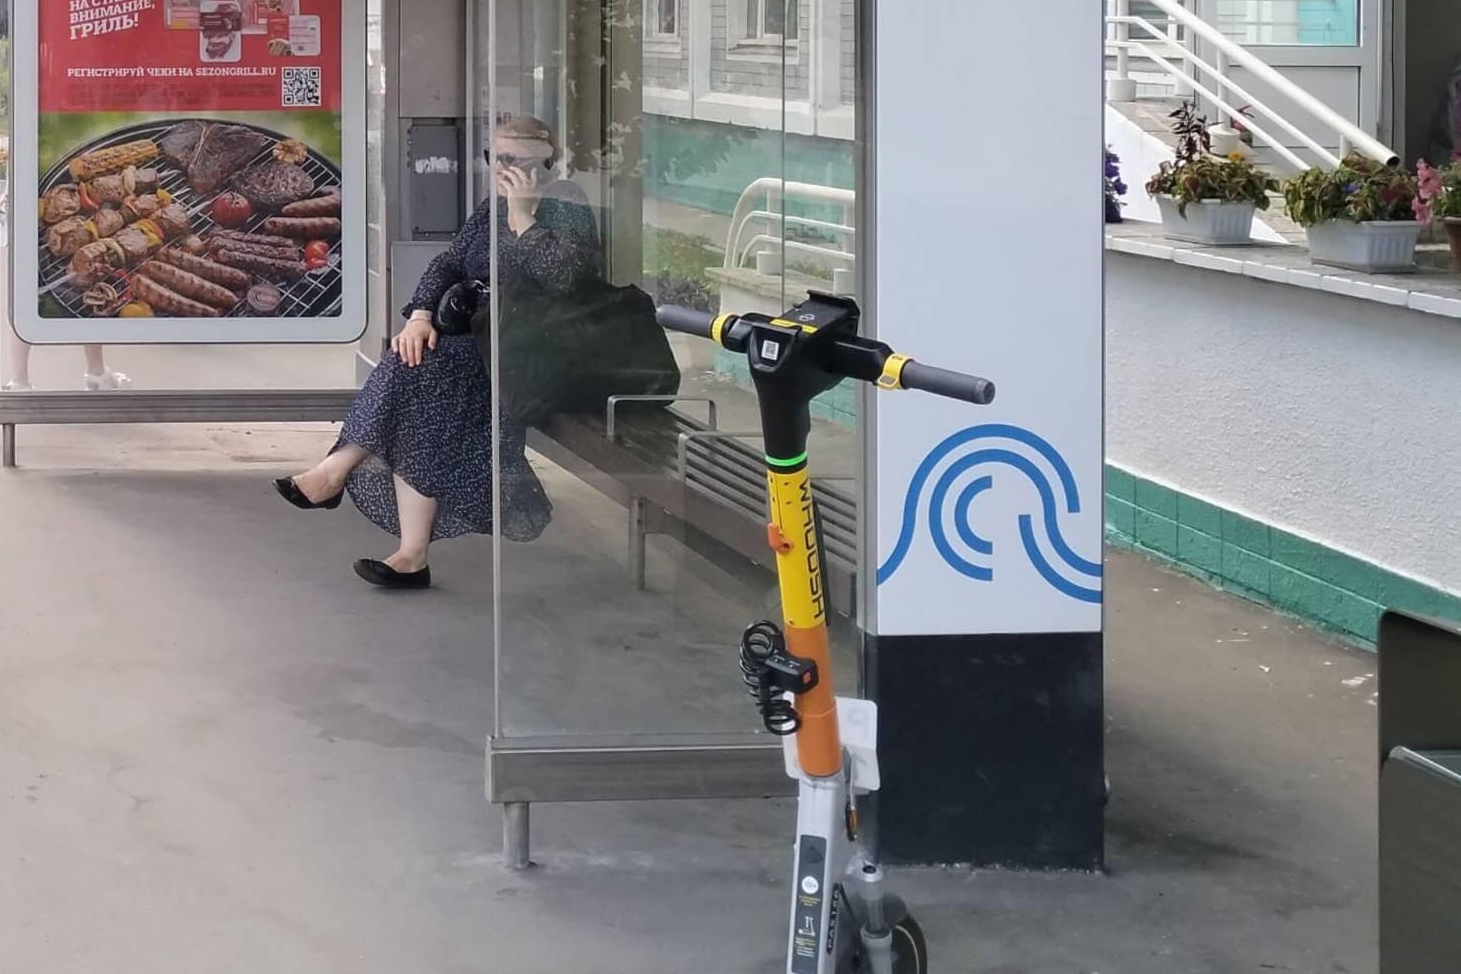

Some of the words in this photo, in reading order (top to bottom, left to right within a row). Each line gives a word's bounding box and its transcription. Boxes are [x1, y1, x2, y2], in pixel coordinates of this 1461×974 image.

[70, 12, 139, 40] ГРИЛЬ!
[67, 66, 144, 77] РЕГИСТРИРУЙ
[147, 68, 177, 77] ЧЕКИ
[179, 68, 193, 76] НА
[195, 67, 277, 76] SEZONGRILL.RU
[798, 477, 824, 619] WHOOSH
